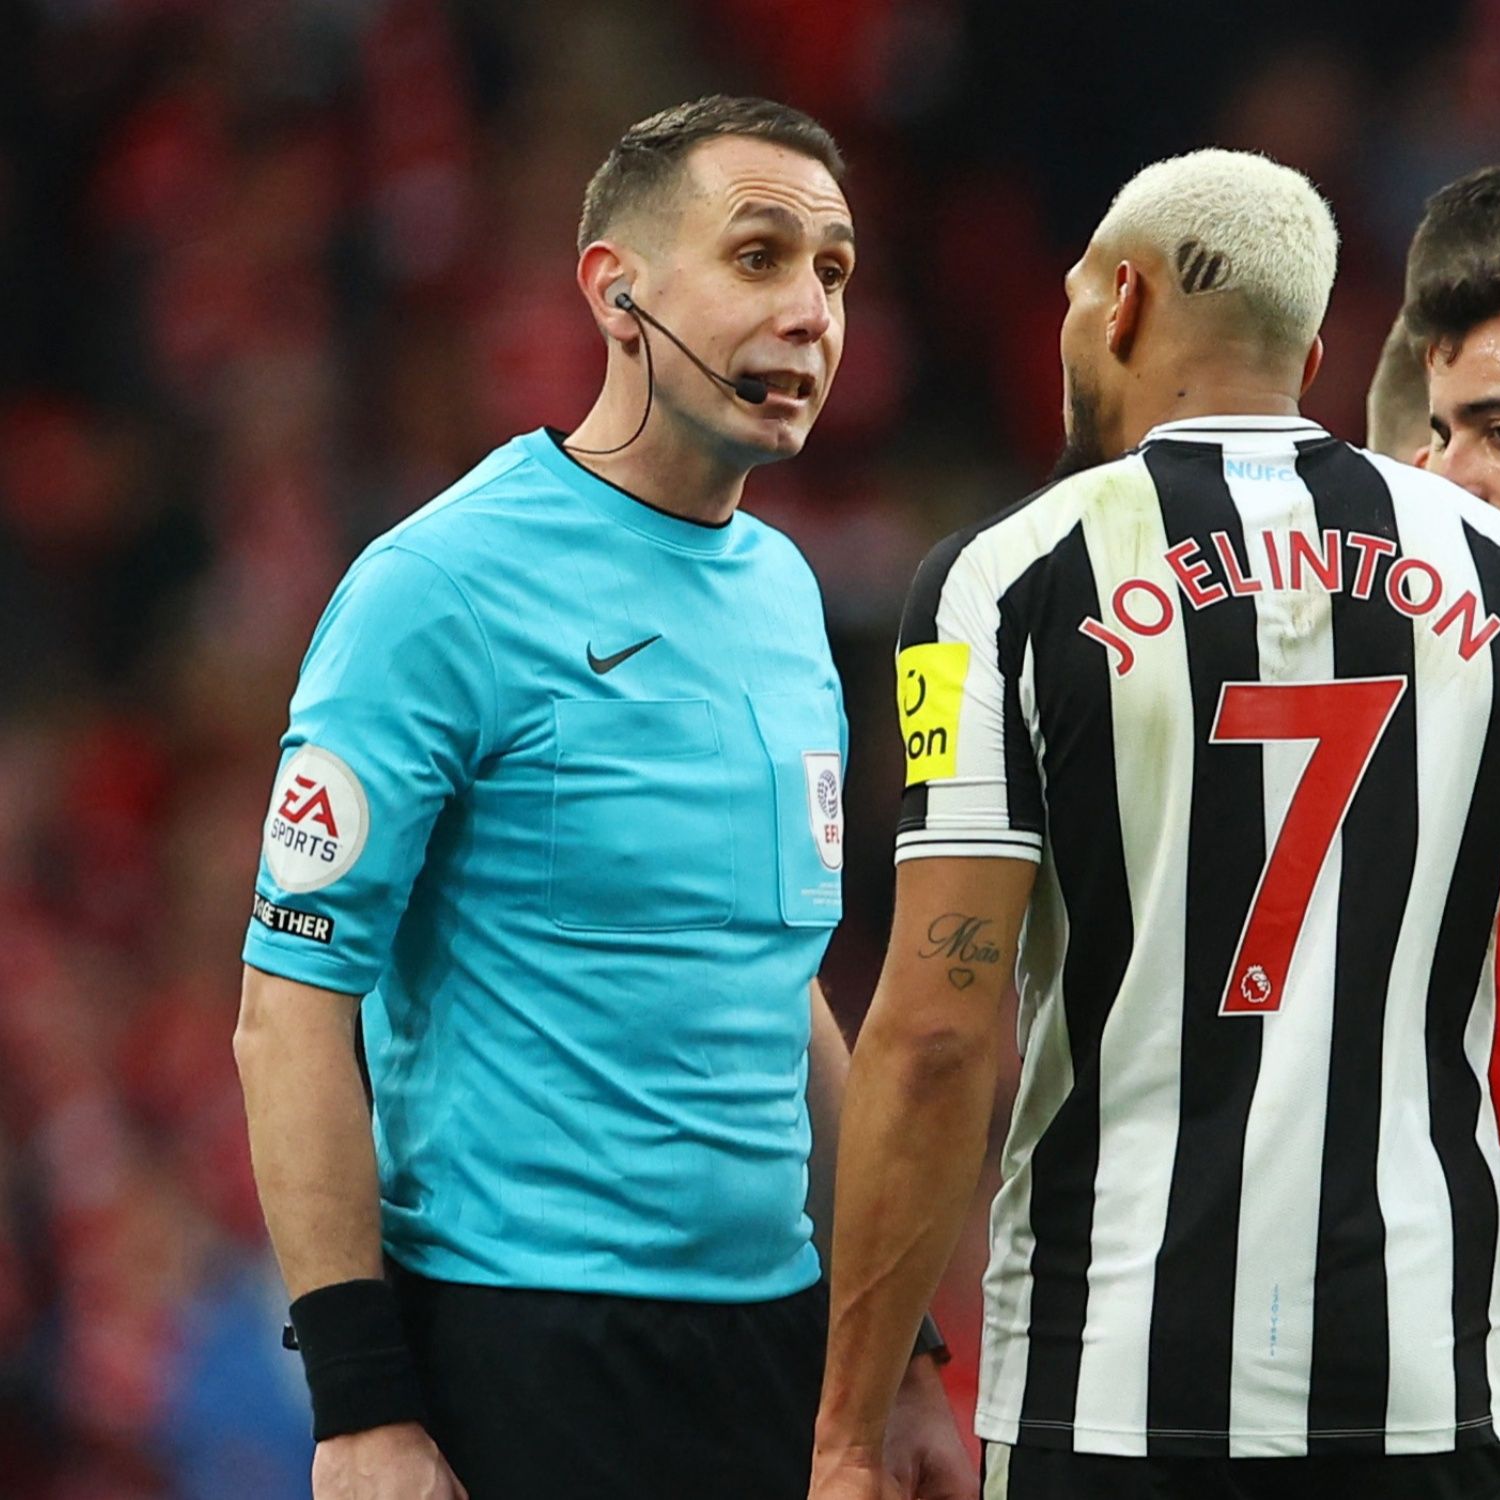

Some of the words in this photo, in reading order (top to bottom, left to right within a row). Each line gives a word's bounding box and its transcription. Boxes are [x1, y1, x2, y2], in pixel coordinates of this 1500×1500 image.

[1226, 459, 1295, 481] NUFC
[278, 774, 339, 838] EA
[271, 818, 338, 864] SPORTS
[1209, 674, 1408, 1017] 7
